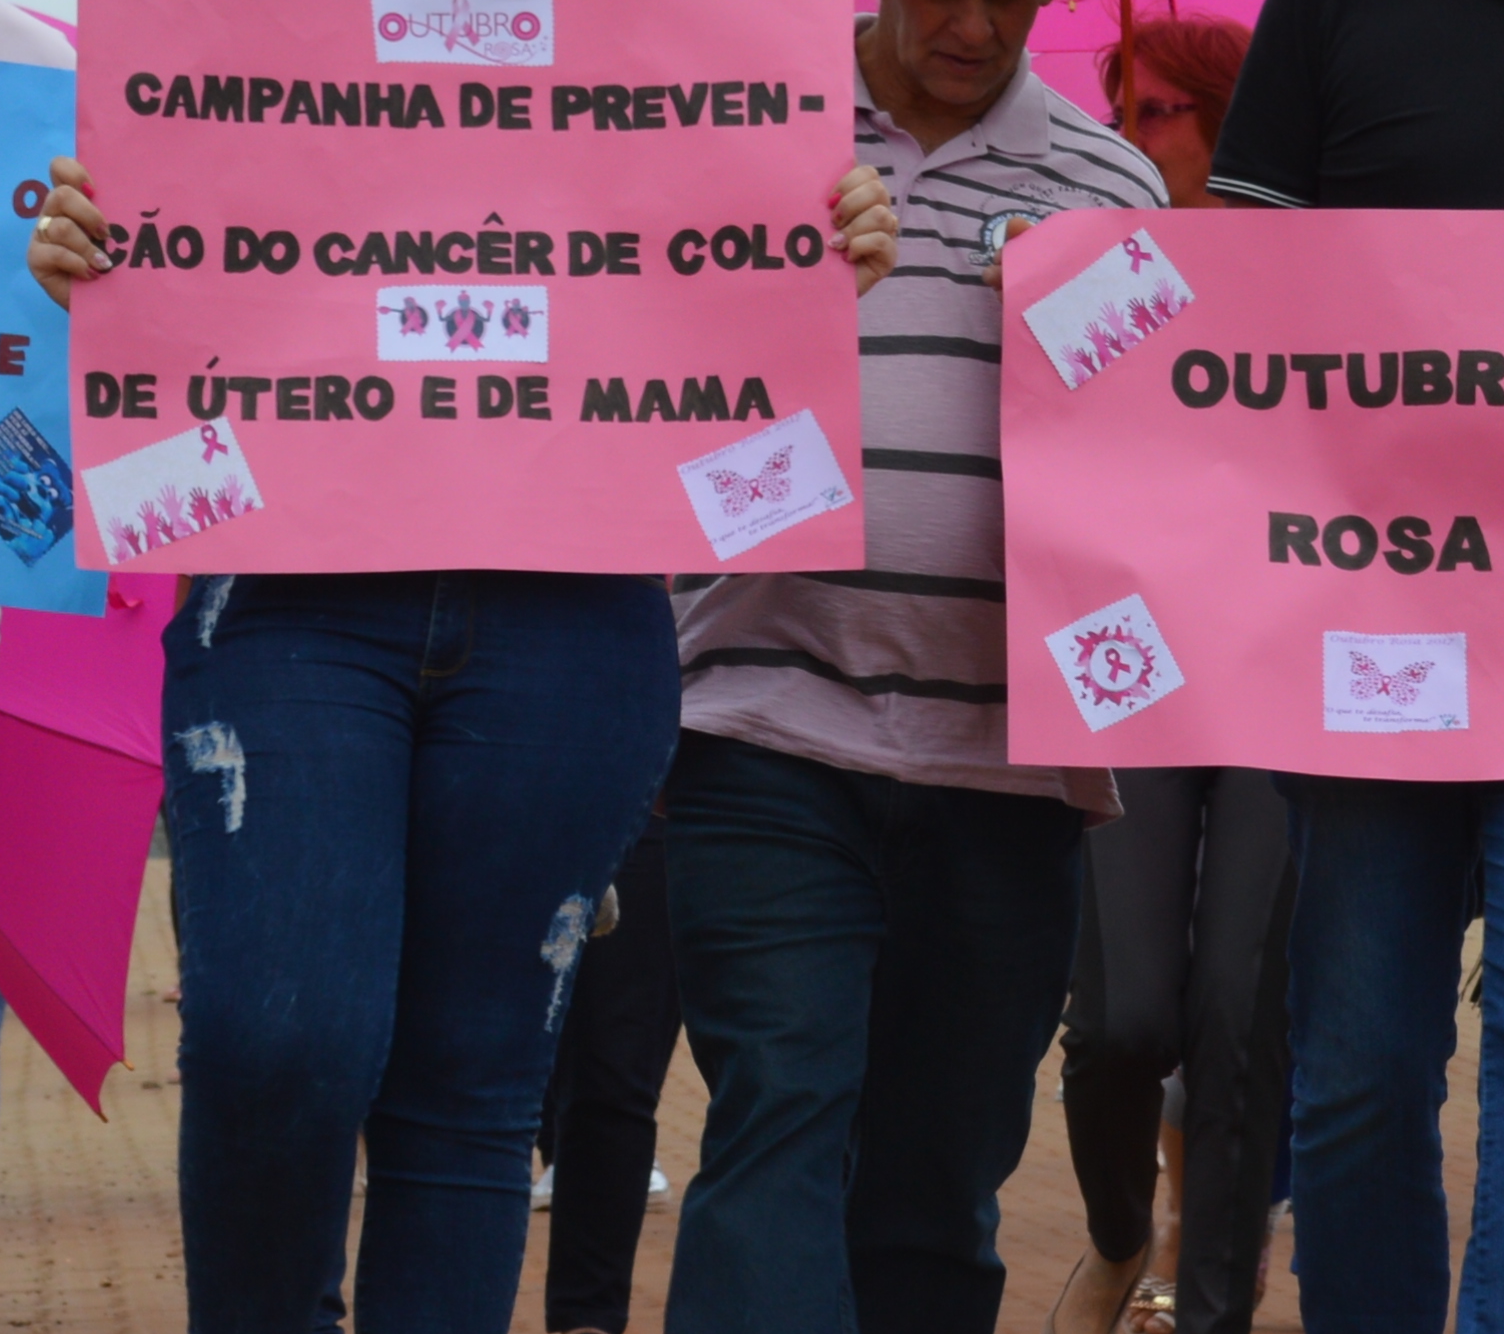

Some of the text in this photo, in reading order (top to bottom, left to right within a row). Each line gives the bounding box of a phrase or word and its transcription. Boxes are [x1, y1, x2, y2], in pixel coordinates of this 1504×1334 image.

[378, 12, 541, 44] OUTUBRO
[484, 41, 533, 60] ROSA
[125, 72, 444, 129] CAMPANHA
[460, 83, 532, 130] DE
[224, 226, 300, 275] DO
[313, 212, 555, 276] CANCÊR
[568, 231, 641, 277] DE
[667, 224, 824, 271] COLO
[85, 357, 775, 422] DE ÚTERO E DE MAMA
[1269, 513, 1493, 574] ROSA
